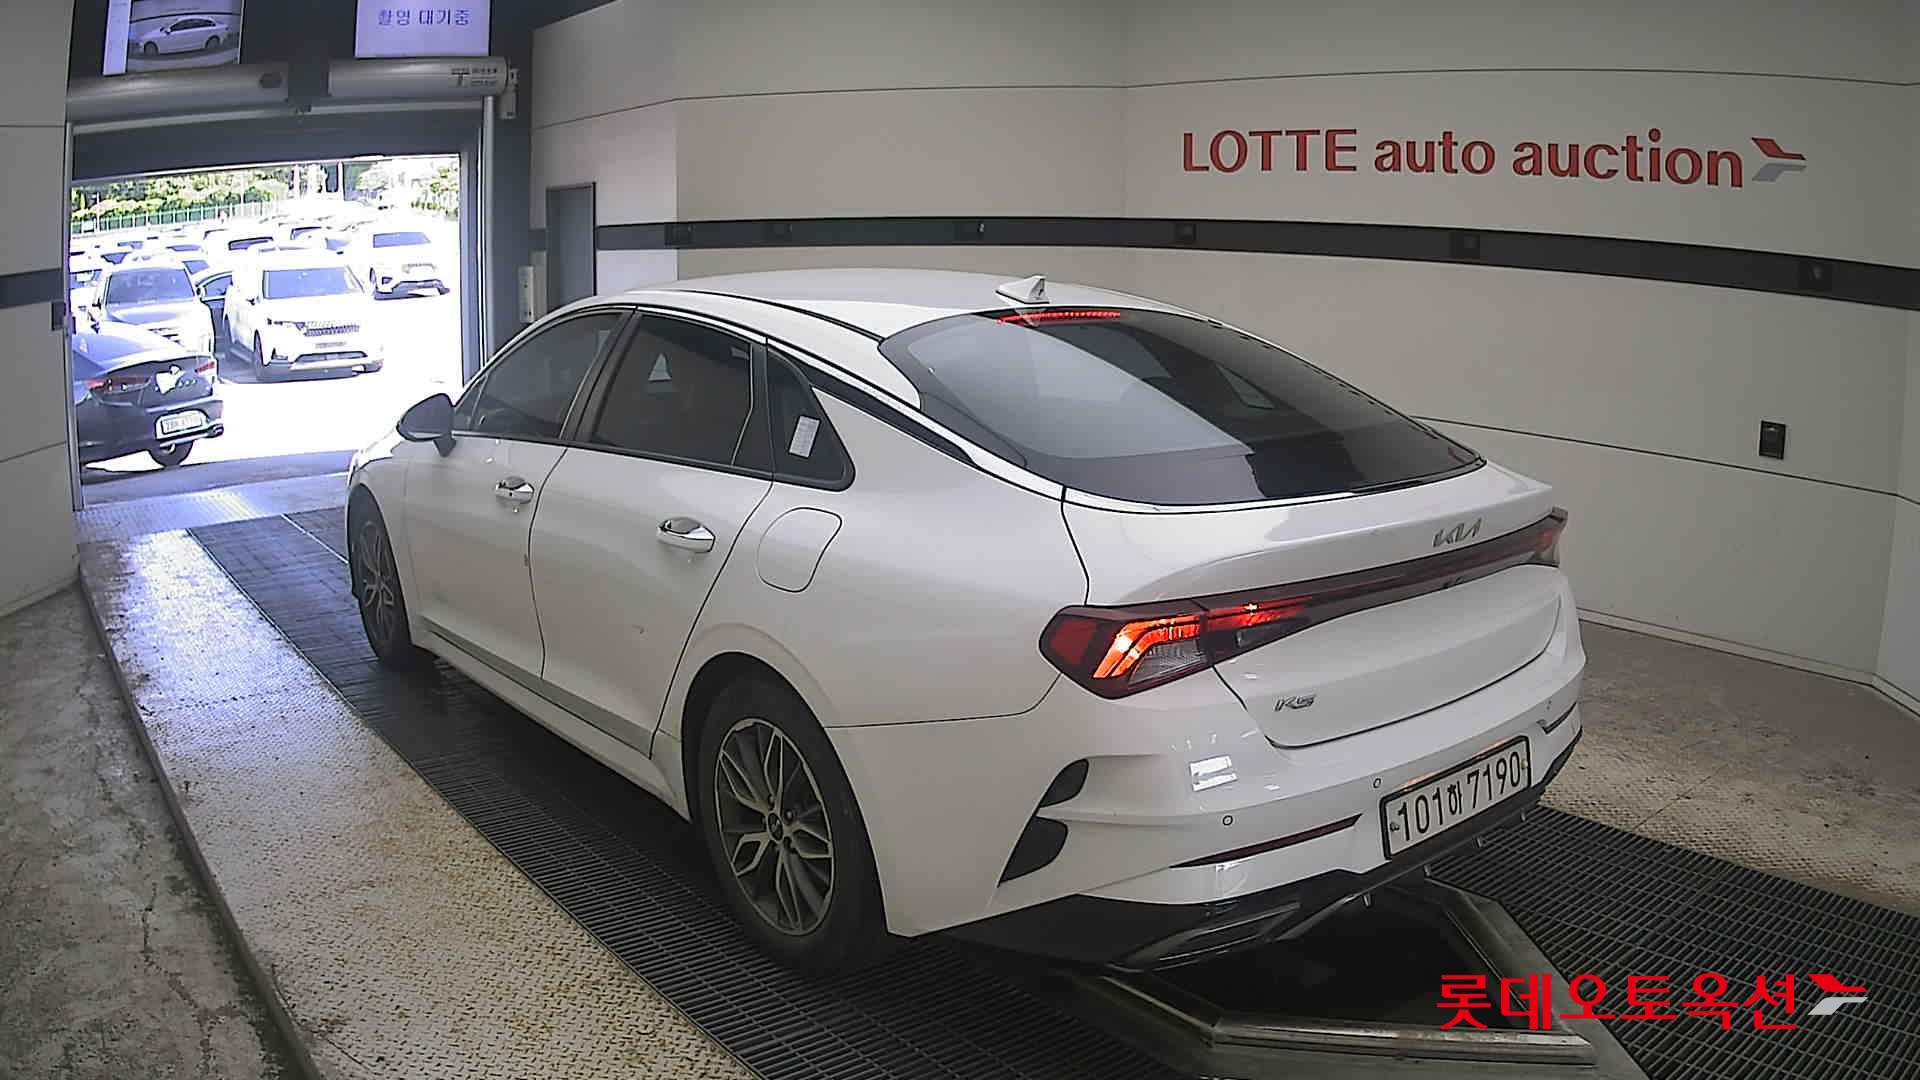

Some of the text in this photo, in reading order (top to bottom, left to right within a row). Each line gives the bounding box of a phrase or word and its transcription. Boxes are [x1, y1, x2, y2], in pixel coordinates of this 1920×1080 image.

[378, 8, 471, 26] 촬영 대기중
[1183, 128, 1744, 188] LOTTE auto auction
[1432, 518, 1483, 547] KIA
[1275, 695, 1317, 712] K5
